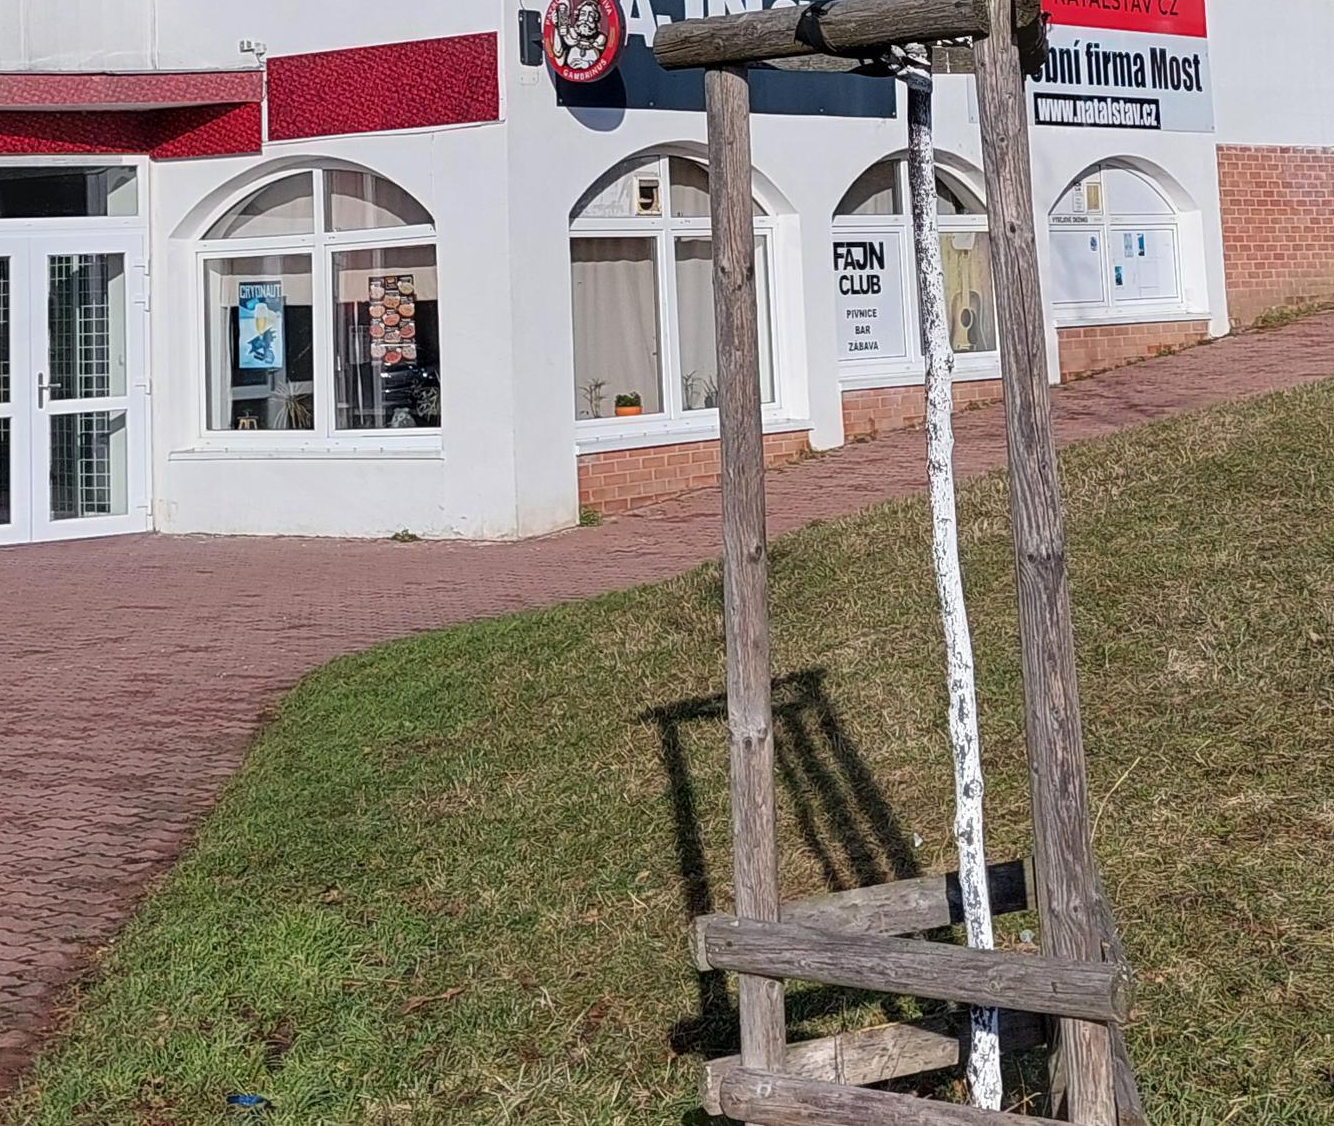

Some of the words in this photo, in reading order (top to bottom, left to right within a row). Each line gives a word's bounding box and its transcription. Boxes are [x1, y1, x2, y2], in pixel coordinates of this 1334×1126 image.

[563, 59, 608, 80] GAMBRINUS
[1085, 42, 1146, 88] firma
[1149, 46, 1203, 92] Most
[1037, 96, 1159, 127] www.natalstav.cz
[833, 242, 885, 271] FAJN
[240, 285, 282, 299] CRYONAUT
[839, 275, 881, 295] CLUB
[846, 309, 878, 319] PIVNICE
[855, 326, 871, 335] BAR
[848, 340, 879, 352] ZÁBAVA
